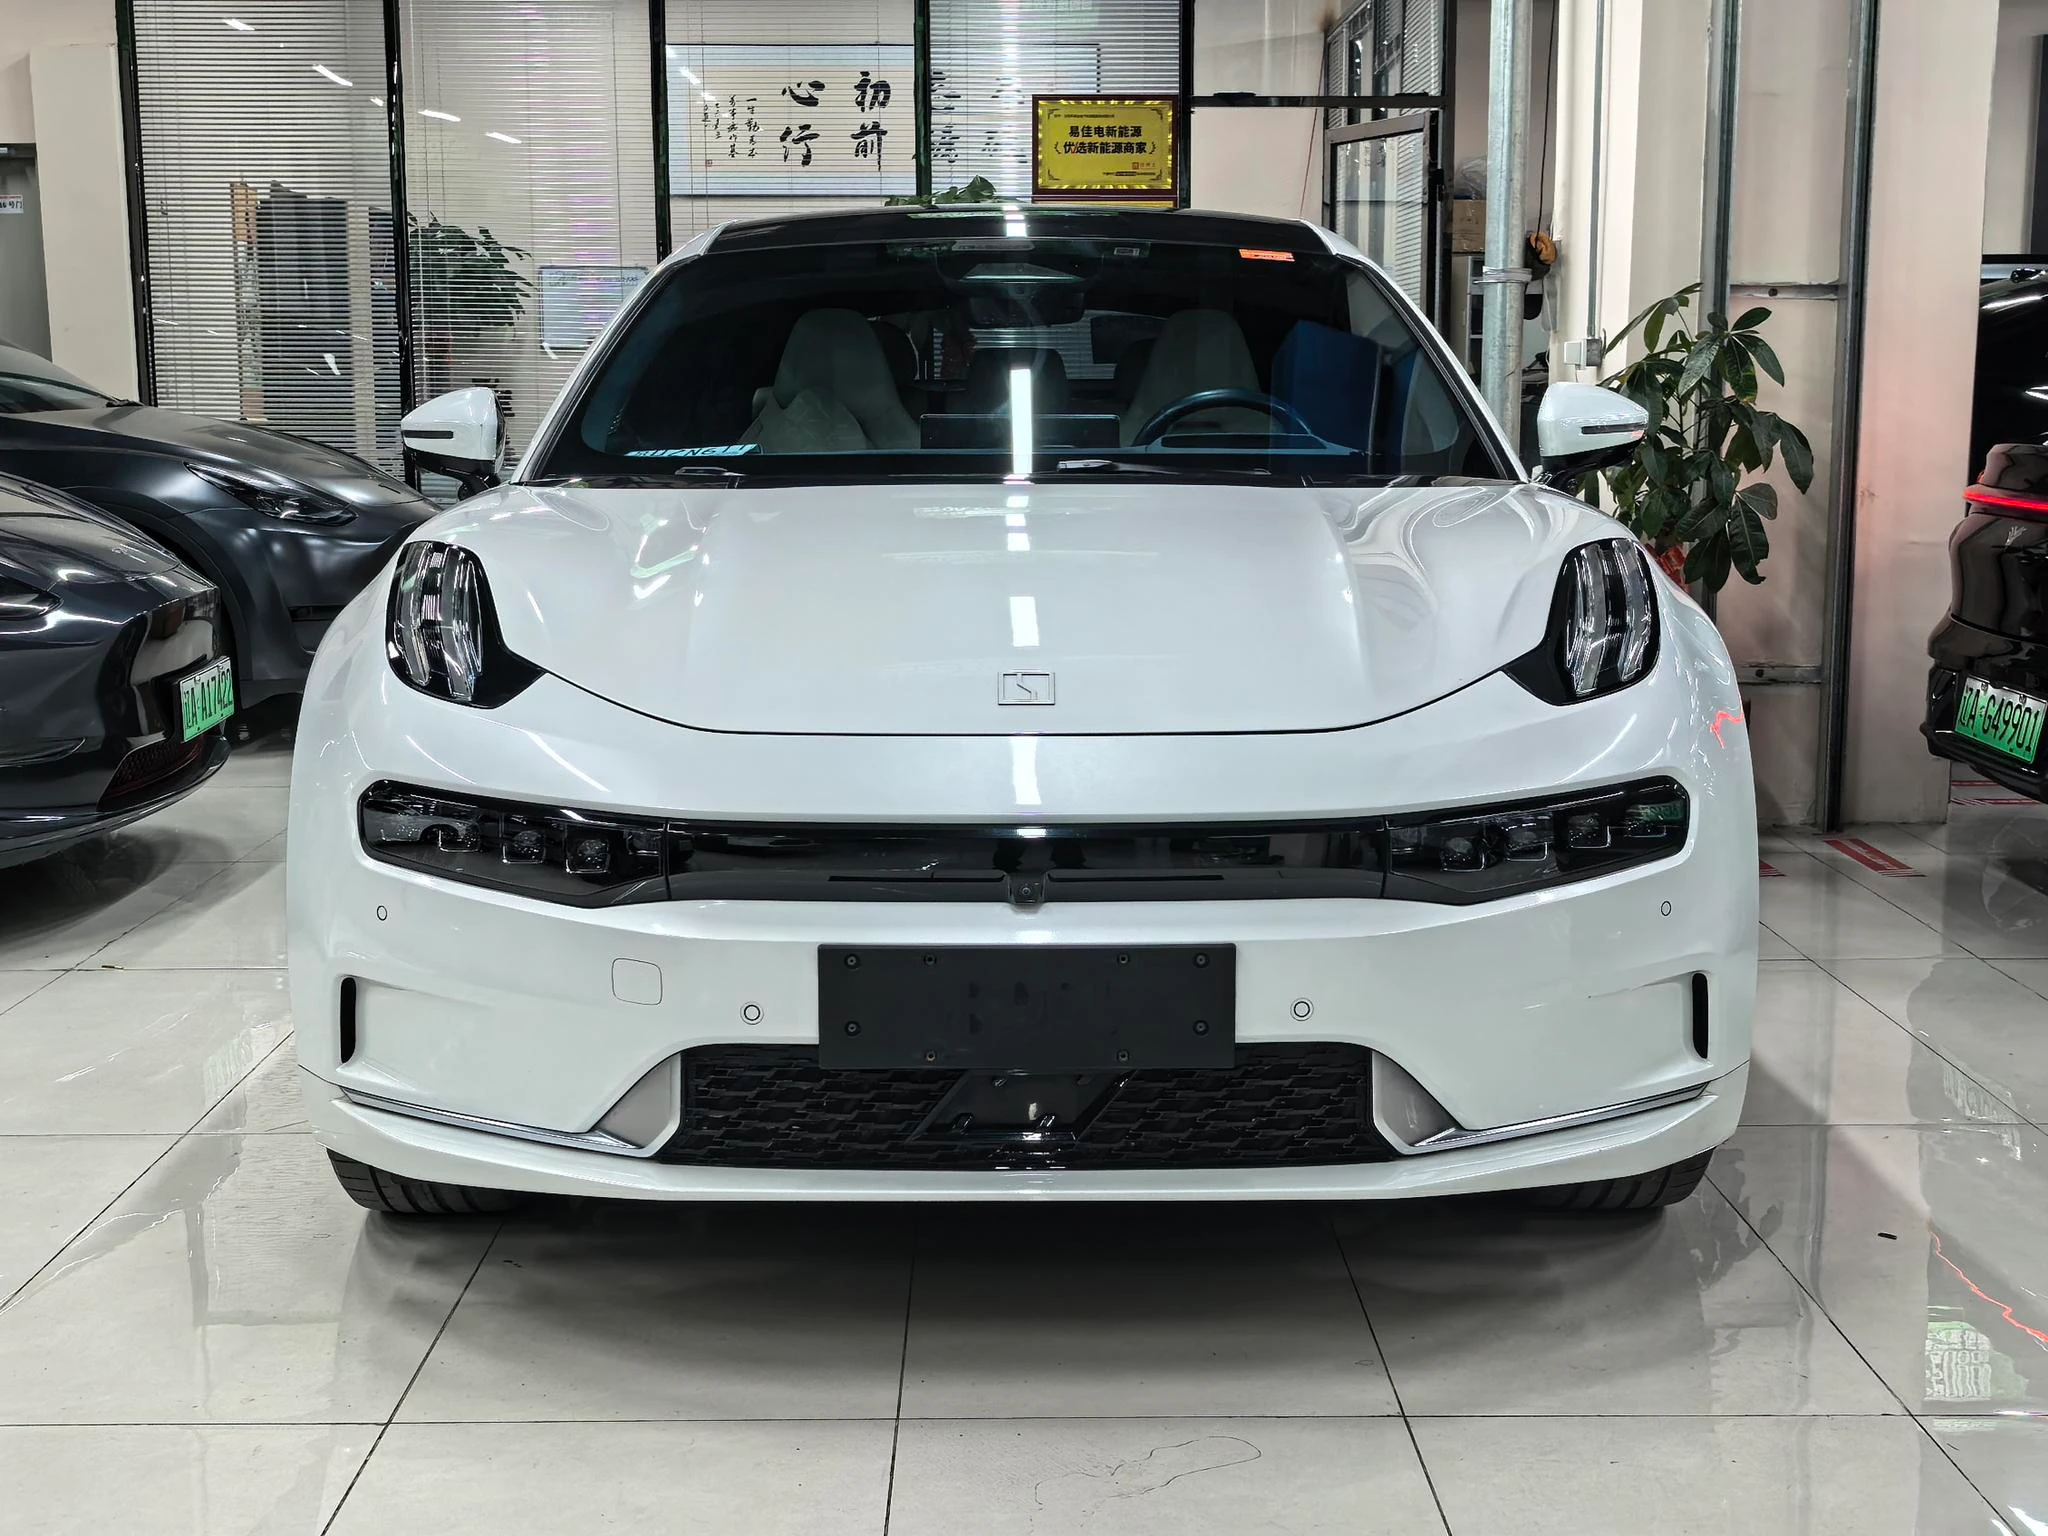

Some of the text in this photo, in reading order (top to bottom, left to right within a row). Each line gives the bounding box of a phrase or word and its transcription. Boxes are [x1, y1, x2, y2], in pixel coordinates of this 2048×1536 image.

[1069, 126, 1142, 138] 易佳电新能源
[1063, 141, 1147, 154] 优选新能源商家
